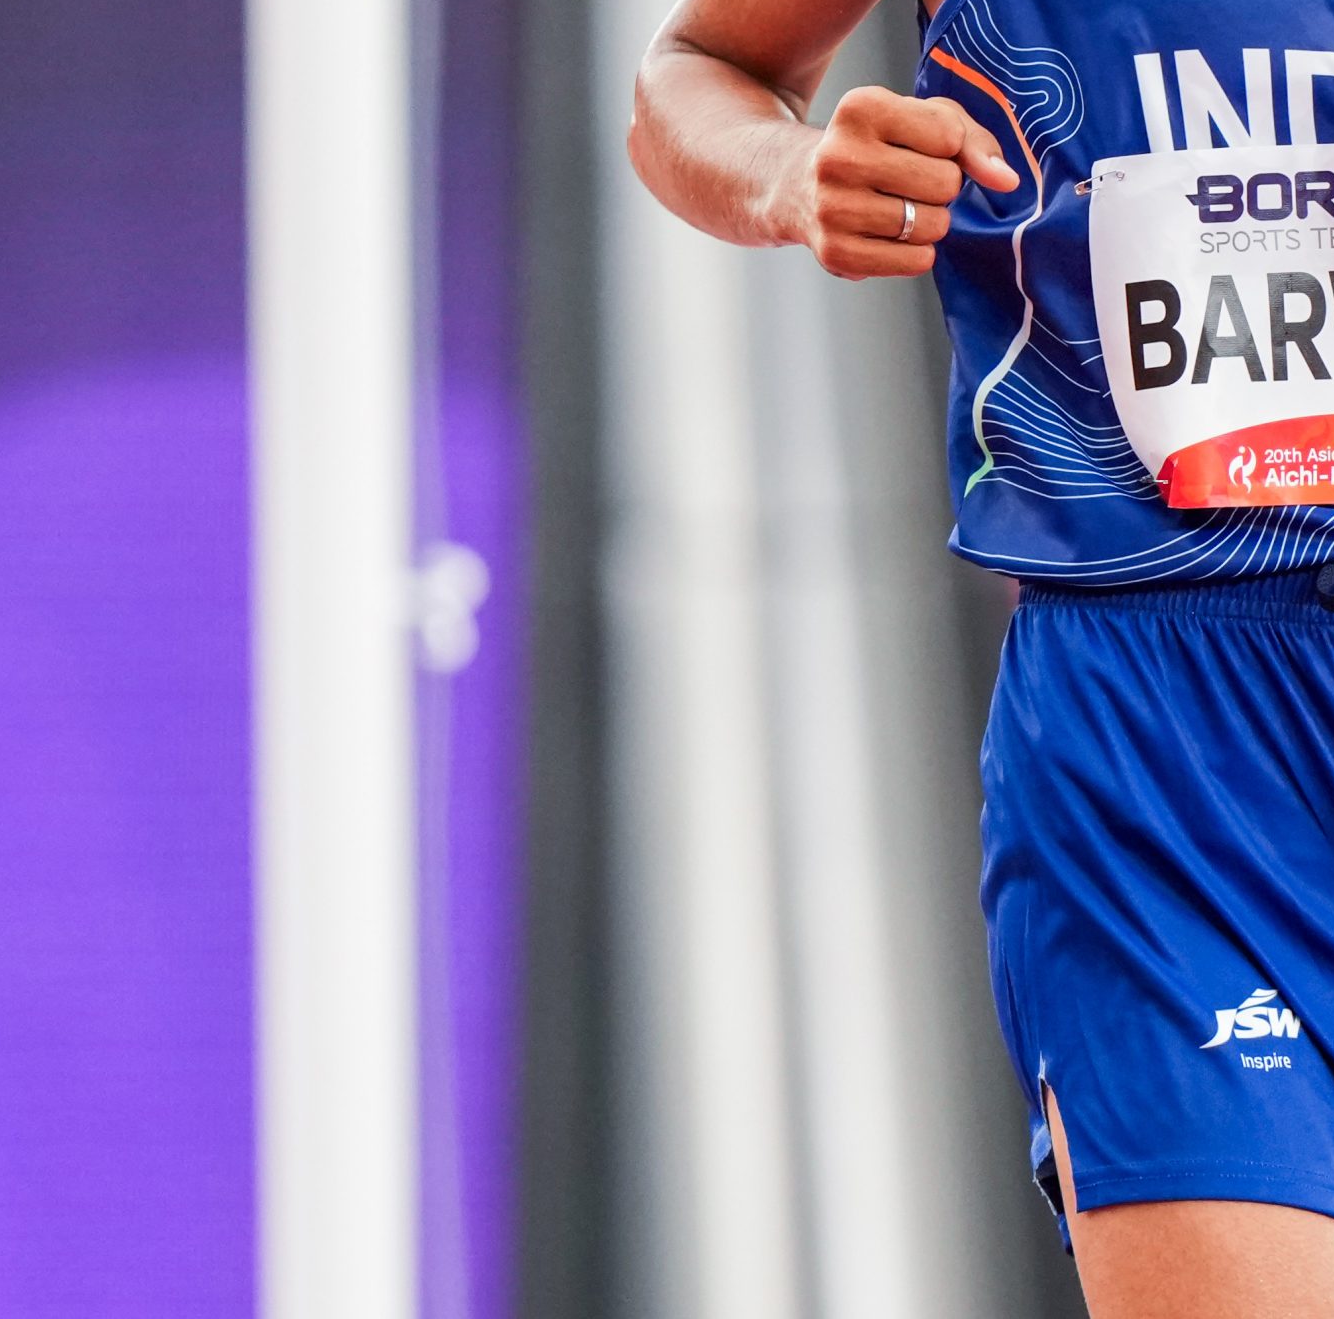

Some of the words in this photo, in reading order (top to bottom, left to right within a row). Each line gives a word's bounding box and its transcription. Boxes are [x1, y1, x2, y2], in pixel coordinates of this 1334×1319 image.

[1200, 229, 1301, 254] SPORTS
[1264, 448, 1302, 464] 20th
[1199, 1006, 1301, 1049] JSW
[1240, 1053, 1292, 1072] Inspire
